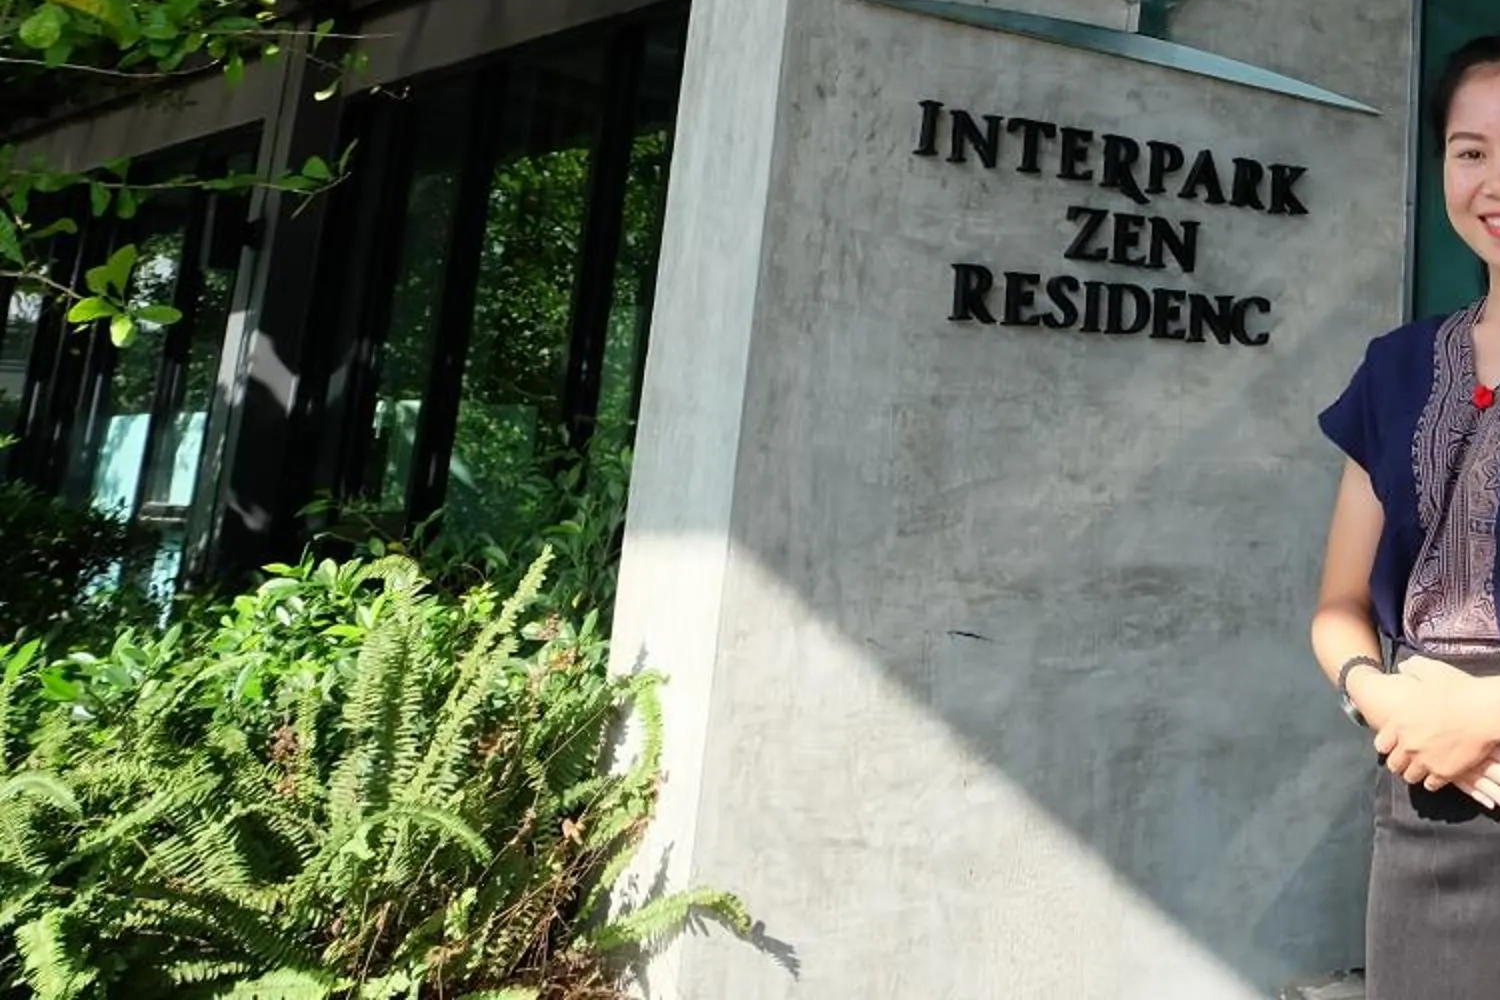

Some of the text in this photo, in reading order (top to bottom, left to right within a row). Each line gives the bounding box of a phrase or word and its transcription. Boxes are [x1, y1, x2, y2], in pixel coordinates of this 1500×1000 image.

[912, 99, 1309, 216] INTERPARK
[1064, 205, 1201, 274] ZEN
[948, 263, 1271, 347] RESIDENC
